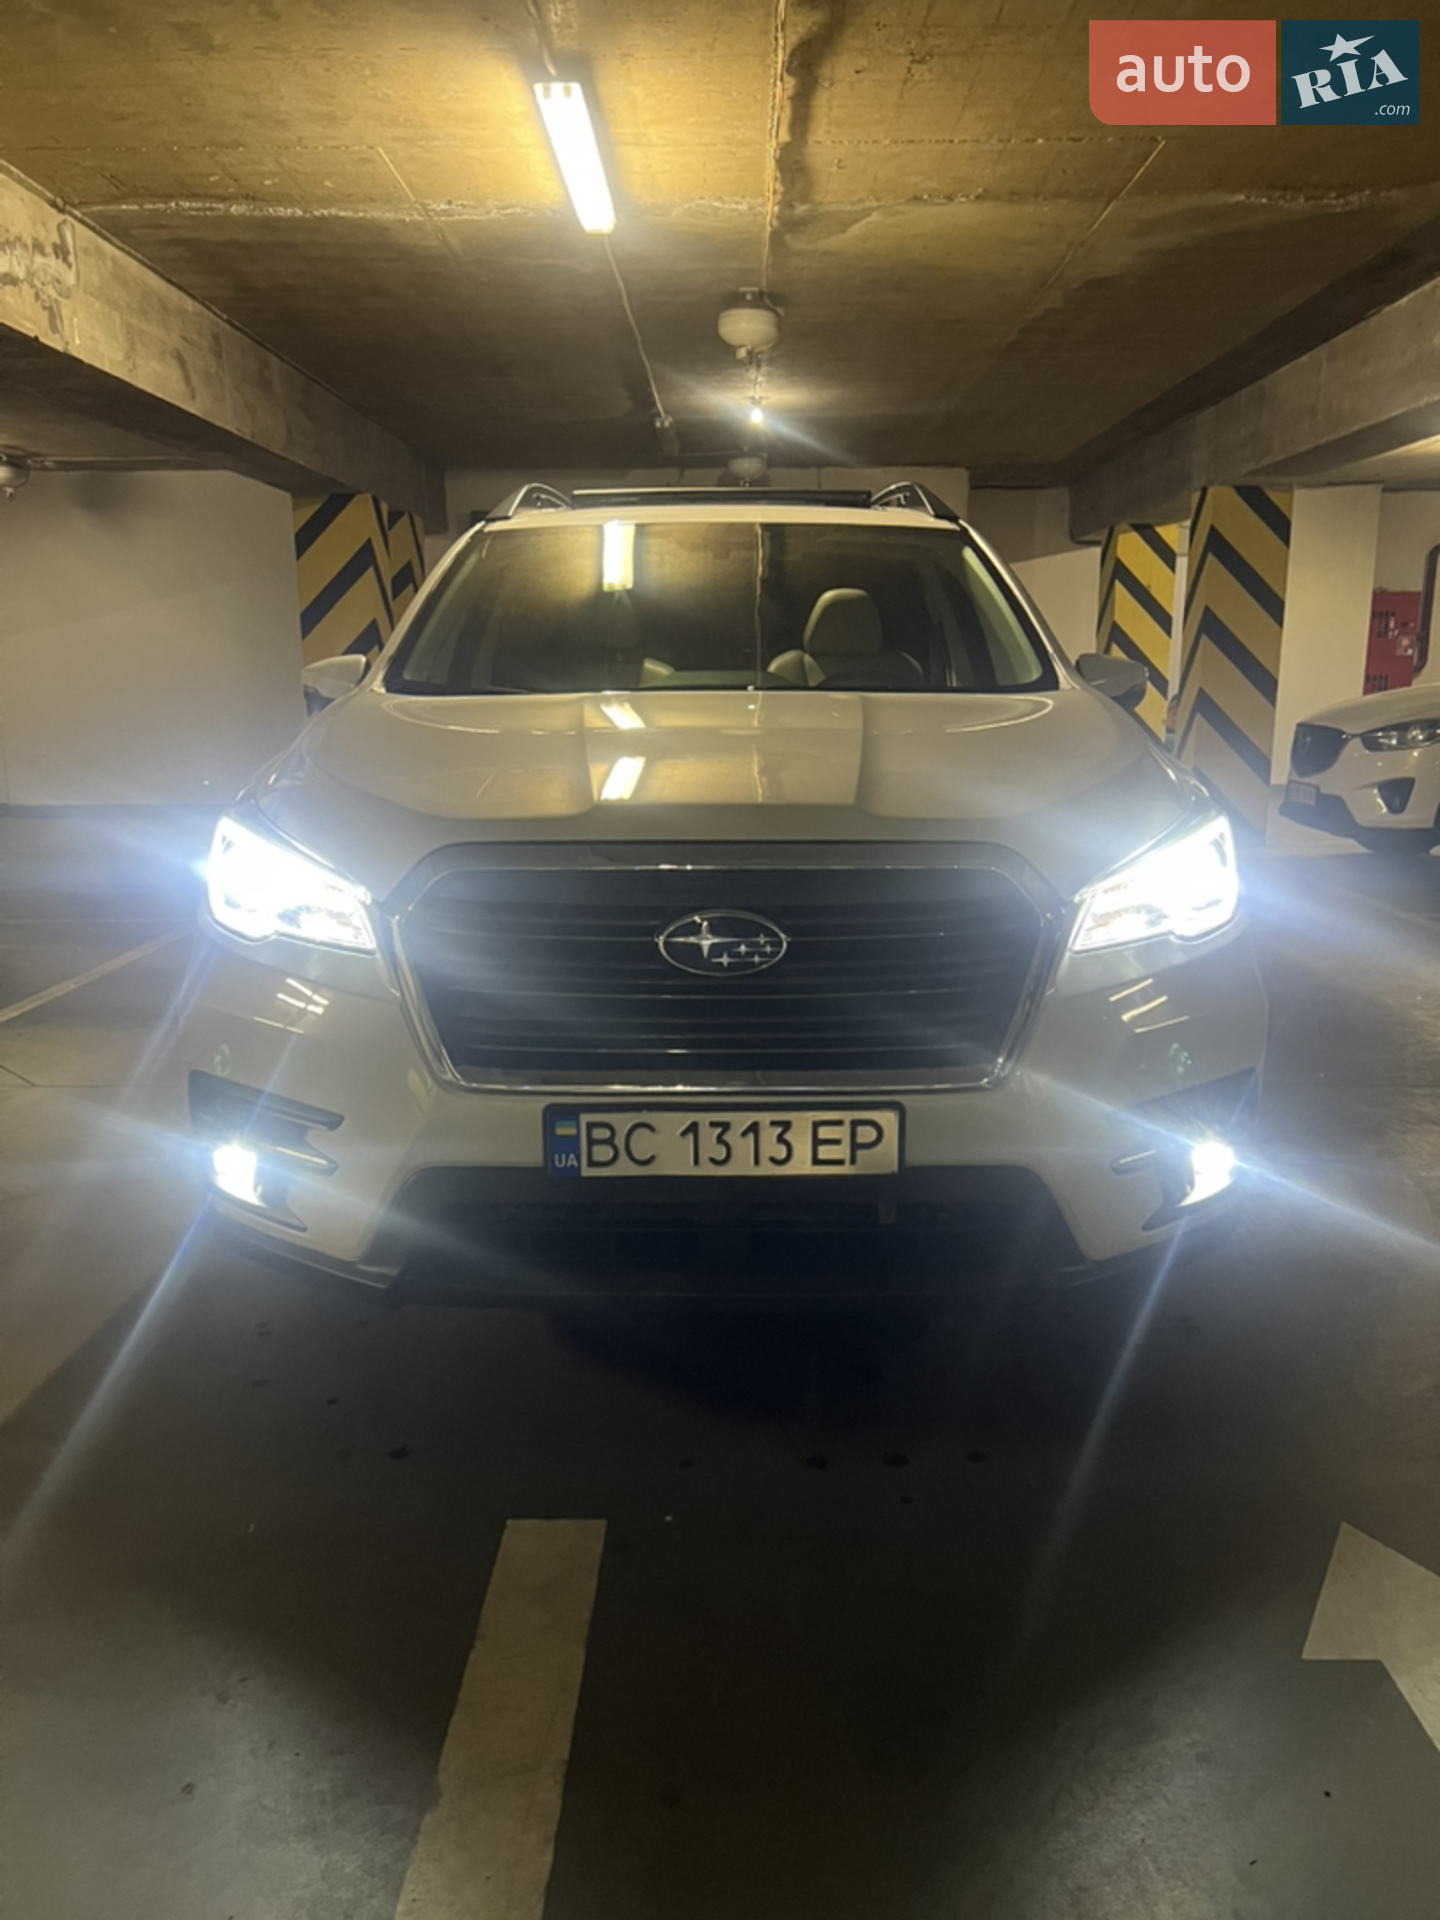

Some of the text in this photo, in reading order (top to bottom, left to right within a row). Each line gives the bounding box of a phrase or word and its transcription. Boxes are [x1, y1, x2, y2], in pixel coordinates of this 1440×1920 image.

[585, 1118, 885, 1169] BC 1313 EP
[555, 1154, 579, 1168] UA
